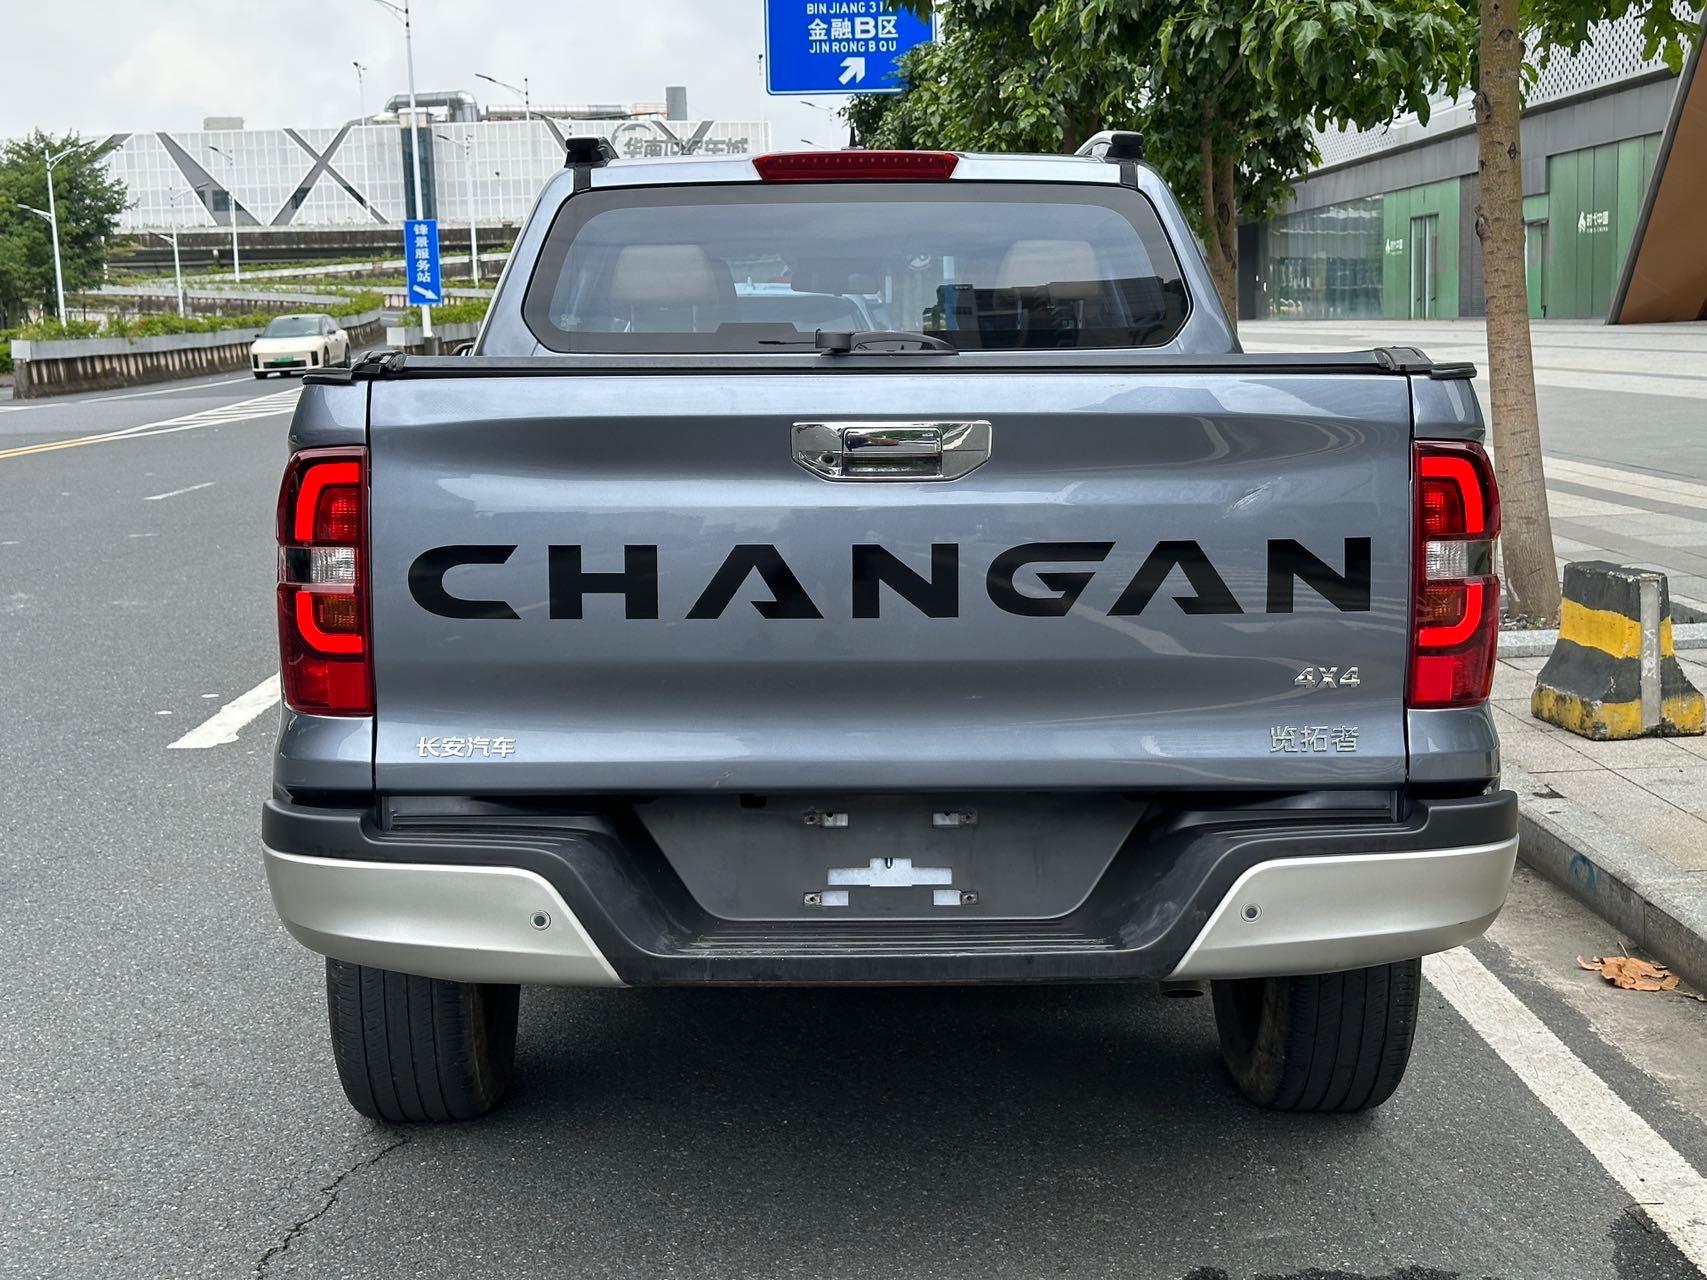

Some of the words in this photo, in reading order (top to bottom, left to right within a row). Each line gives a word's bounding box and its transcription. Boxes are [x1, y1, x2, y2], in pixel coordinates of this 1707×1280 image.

[807, 3, 827, 14] BIN
[829, 2, 866, 14] JIANG
[869, 2, 877, 13] 3
[808, 16, 898, 40] 金融B区
[809, 41, 829, 53] JIN
[832, 41, 866, 53] RONG
[869, 41, 876, 51] B
[879, 40, 897, 52] QU
[408, 537, 1371, 619] CHANGAN
[1294, 667, 1360, 688] 4X4
[417, 736, 516, 758] 长安汽车
[1270, 725, 1360, 753] 览拓者
